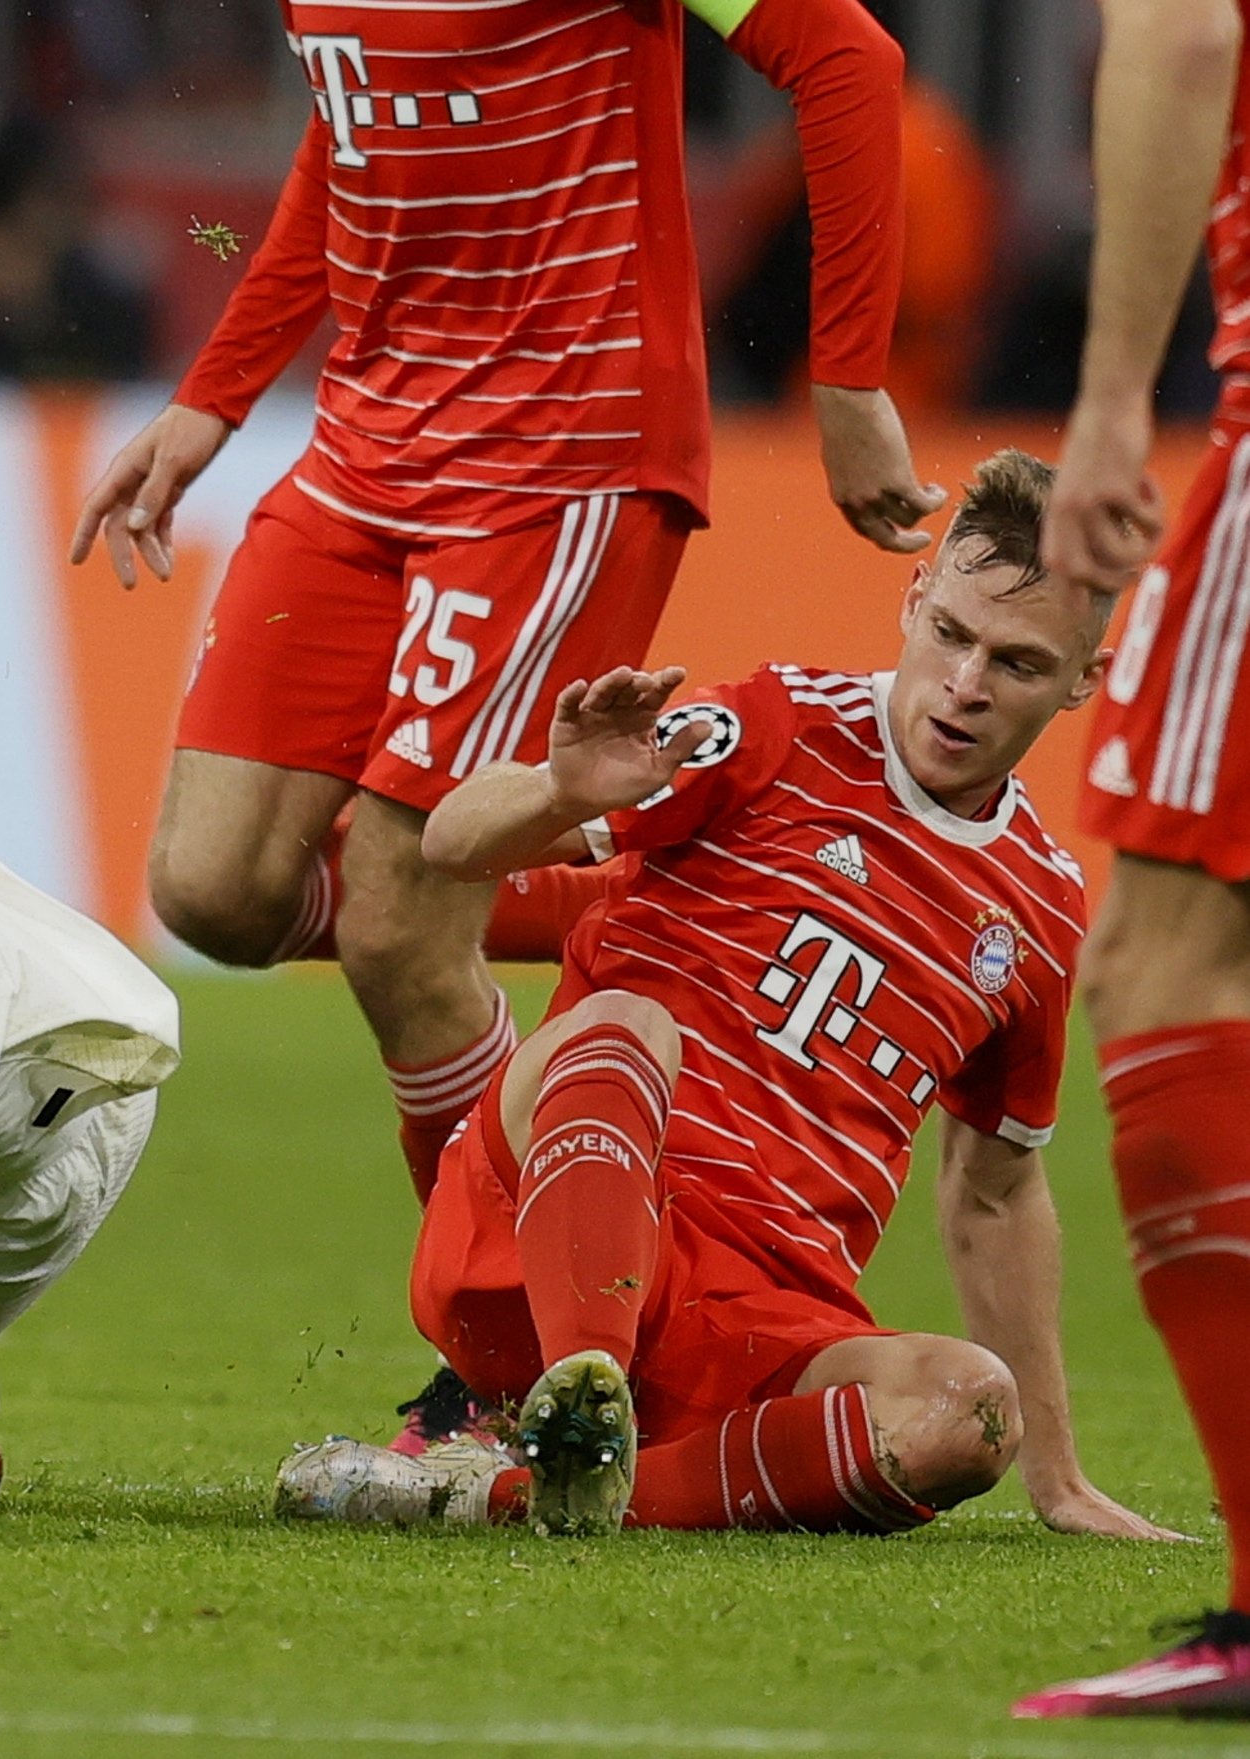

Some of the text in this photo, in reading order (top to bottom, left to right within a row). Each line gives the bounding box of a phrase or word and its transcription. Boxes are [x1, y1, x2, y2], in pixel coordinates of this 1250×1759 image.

[388, 576, 492, 707] 25
[815, 848, 869, 885] adidas
[533, 1133, 631, 1178] BAYERN
